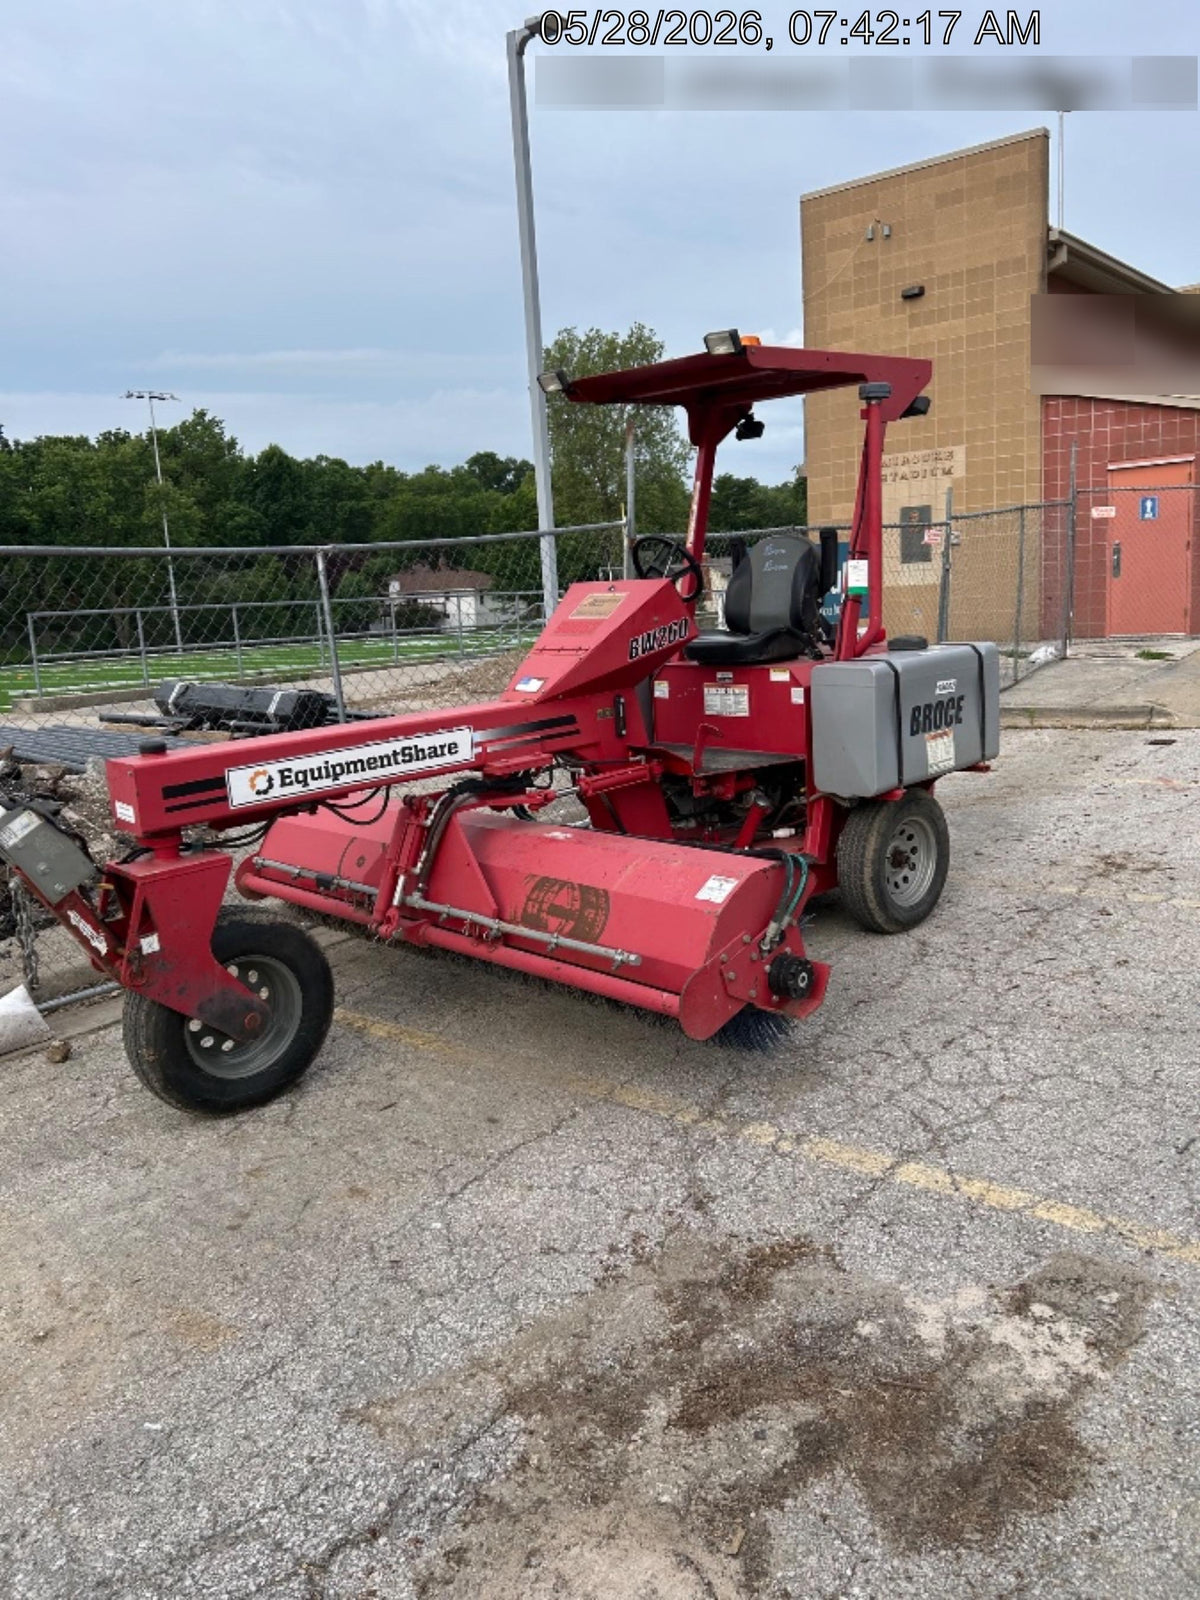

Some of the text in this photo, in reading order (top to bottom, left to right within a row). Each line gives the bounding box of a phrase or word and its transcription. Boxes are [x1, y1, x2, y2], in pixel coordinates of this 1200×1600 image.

[628, 617, 689, 662] BW260
[910, 694, 965, 737] BROCE
[277, 740, 460, 789] EquipmentShare
